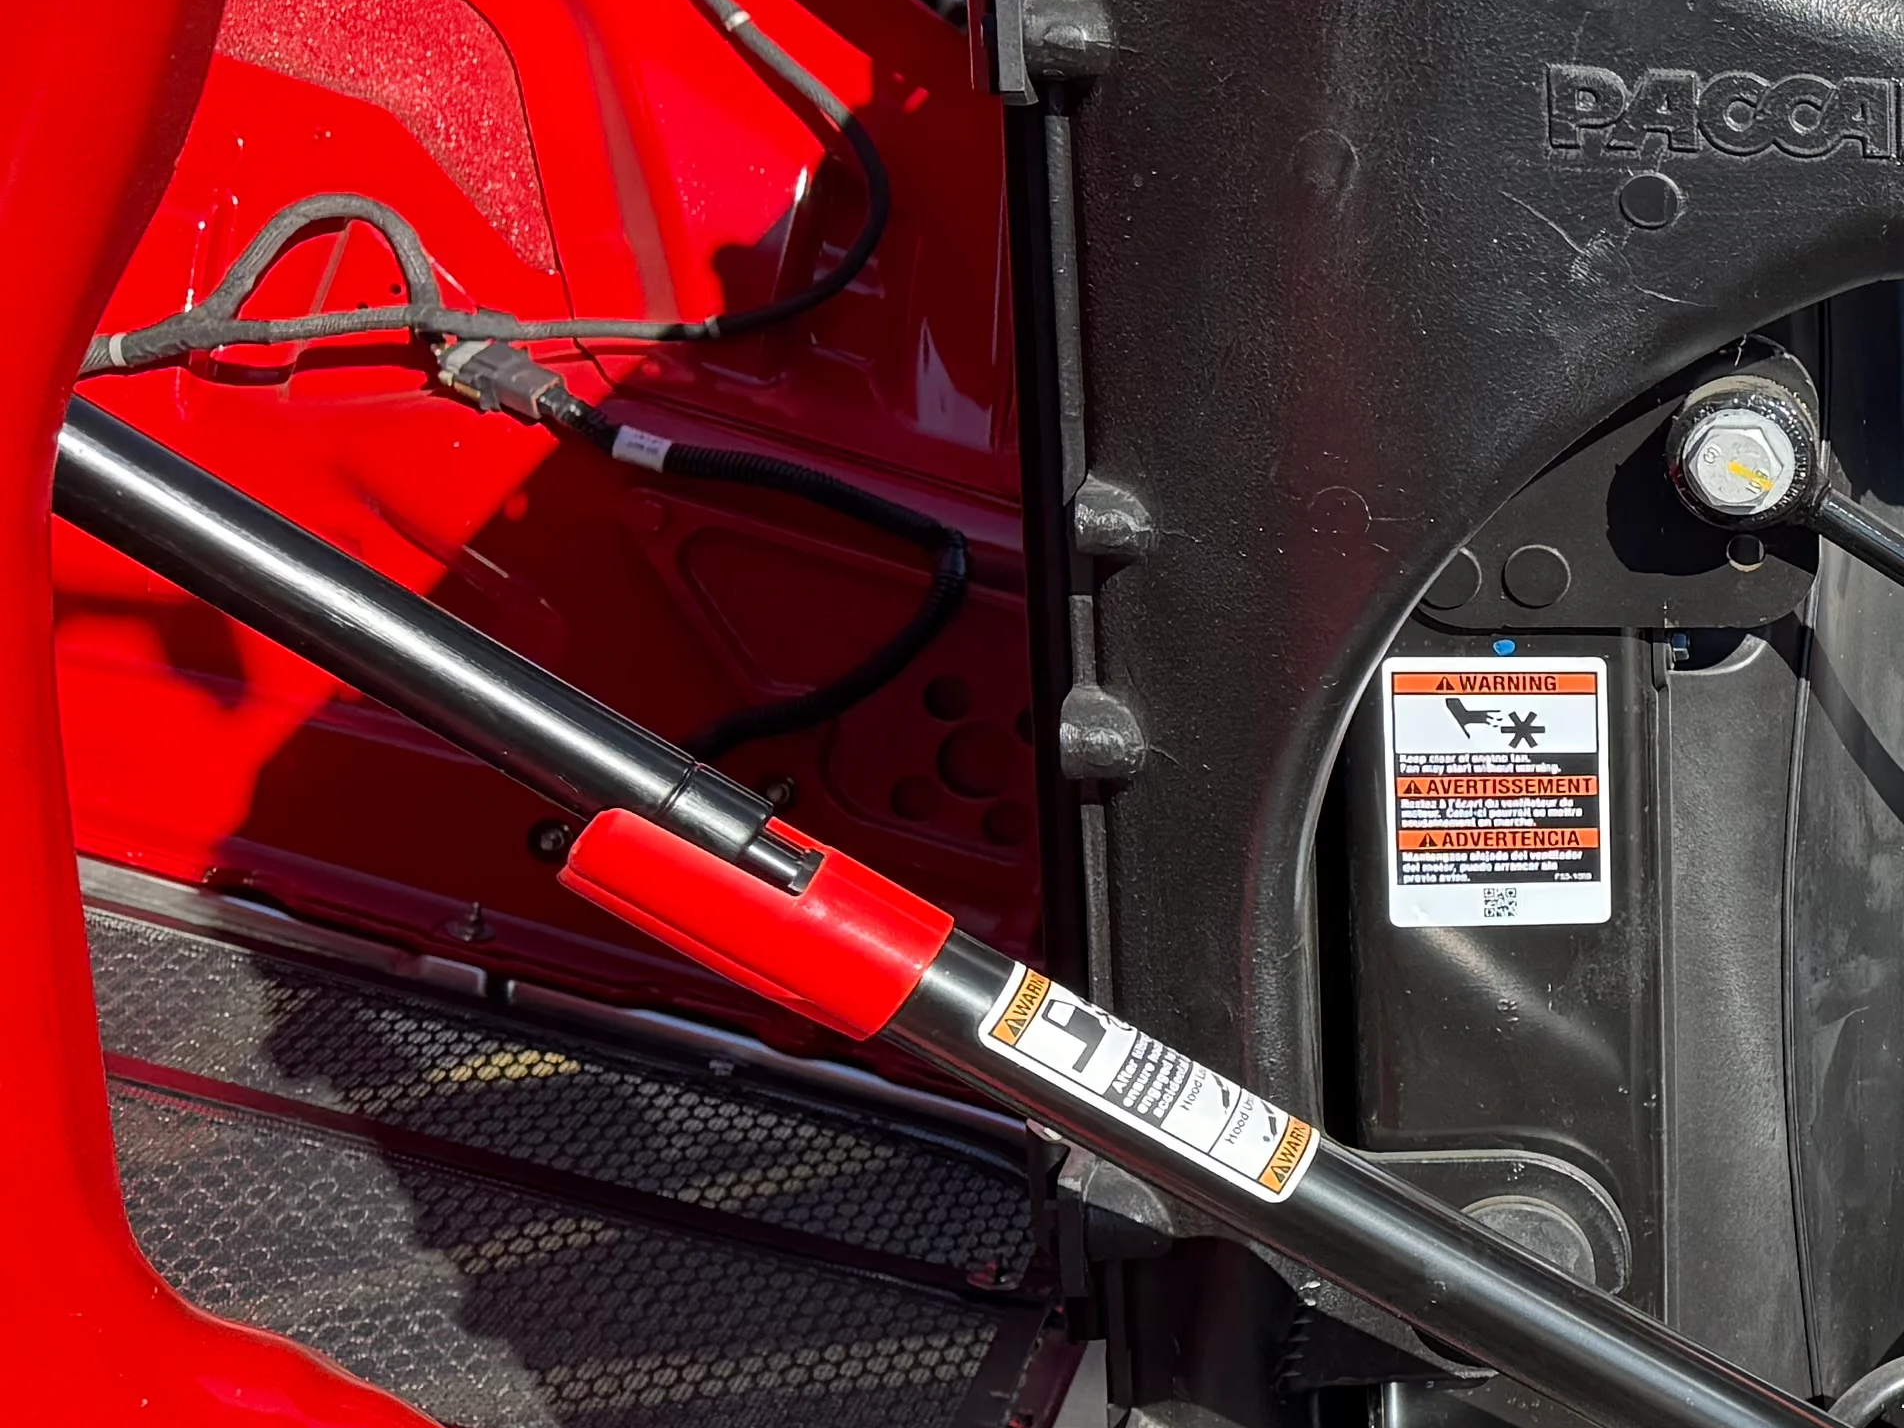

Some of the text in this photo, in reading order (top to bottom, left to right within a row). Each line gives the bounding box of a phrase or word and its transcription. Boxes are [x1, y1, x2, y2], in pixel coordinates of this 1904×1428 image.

[1459, 675, 1557, 692] WARNING
[1426, 776, 1592, 795] AVERTISSEMENT
[1442, 830, 1579, 847] ADVERTENCIA
[1179, 1079, 1203, 1110] Hood
